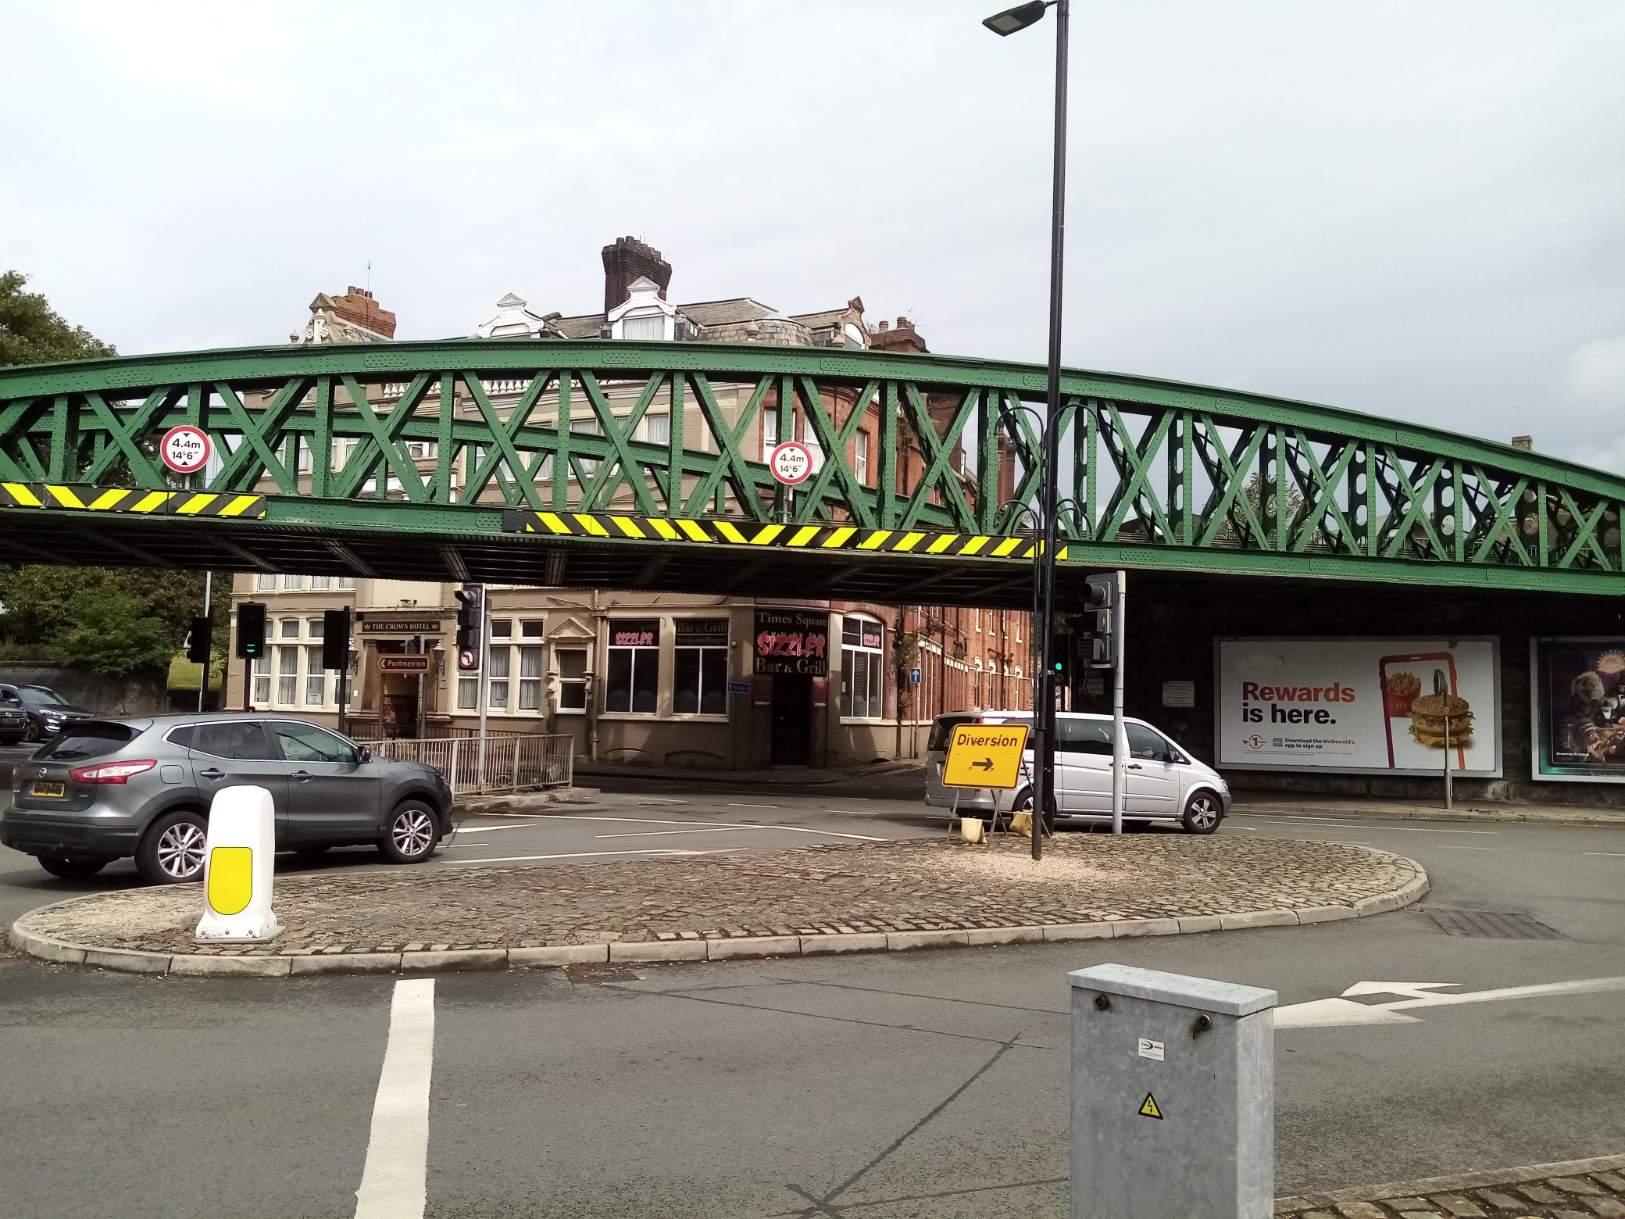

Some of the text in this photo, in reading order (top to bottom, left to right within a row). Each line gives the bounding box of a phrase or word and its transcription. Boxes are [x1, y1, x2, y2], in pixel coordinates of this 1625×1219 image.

[172, 438, 201, 449] 4.4m
[780, 453, 804, 463] 4.4m
[757, 611, 827, 629] Times Square
[615, 631, 654, 646] SIZZLER
[757, 631, 826, 658] SIZZLER
[387, 659, 426, 668] Portmeirion
[755, 656, 827, 675] Bar & Grill
[1242, 681, 1356, 703] Rewards
[1242, 702, 1337, 725] is here.
[957, 733, 1018, 747] Diversion
